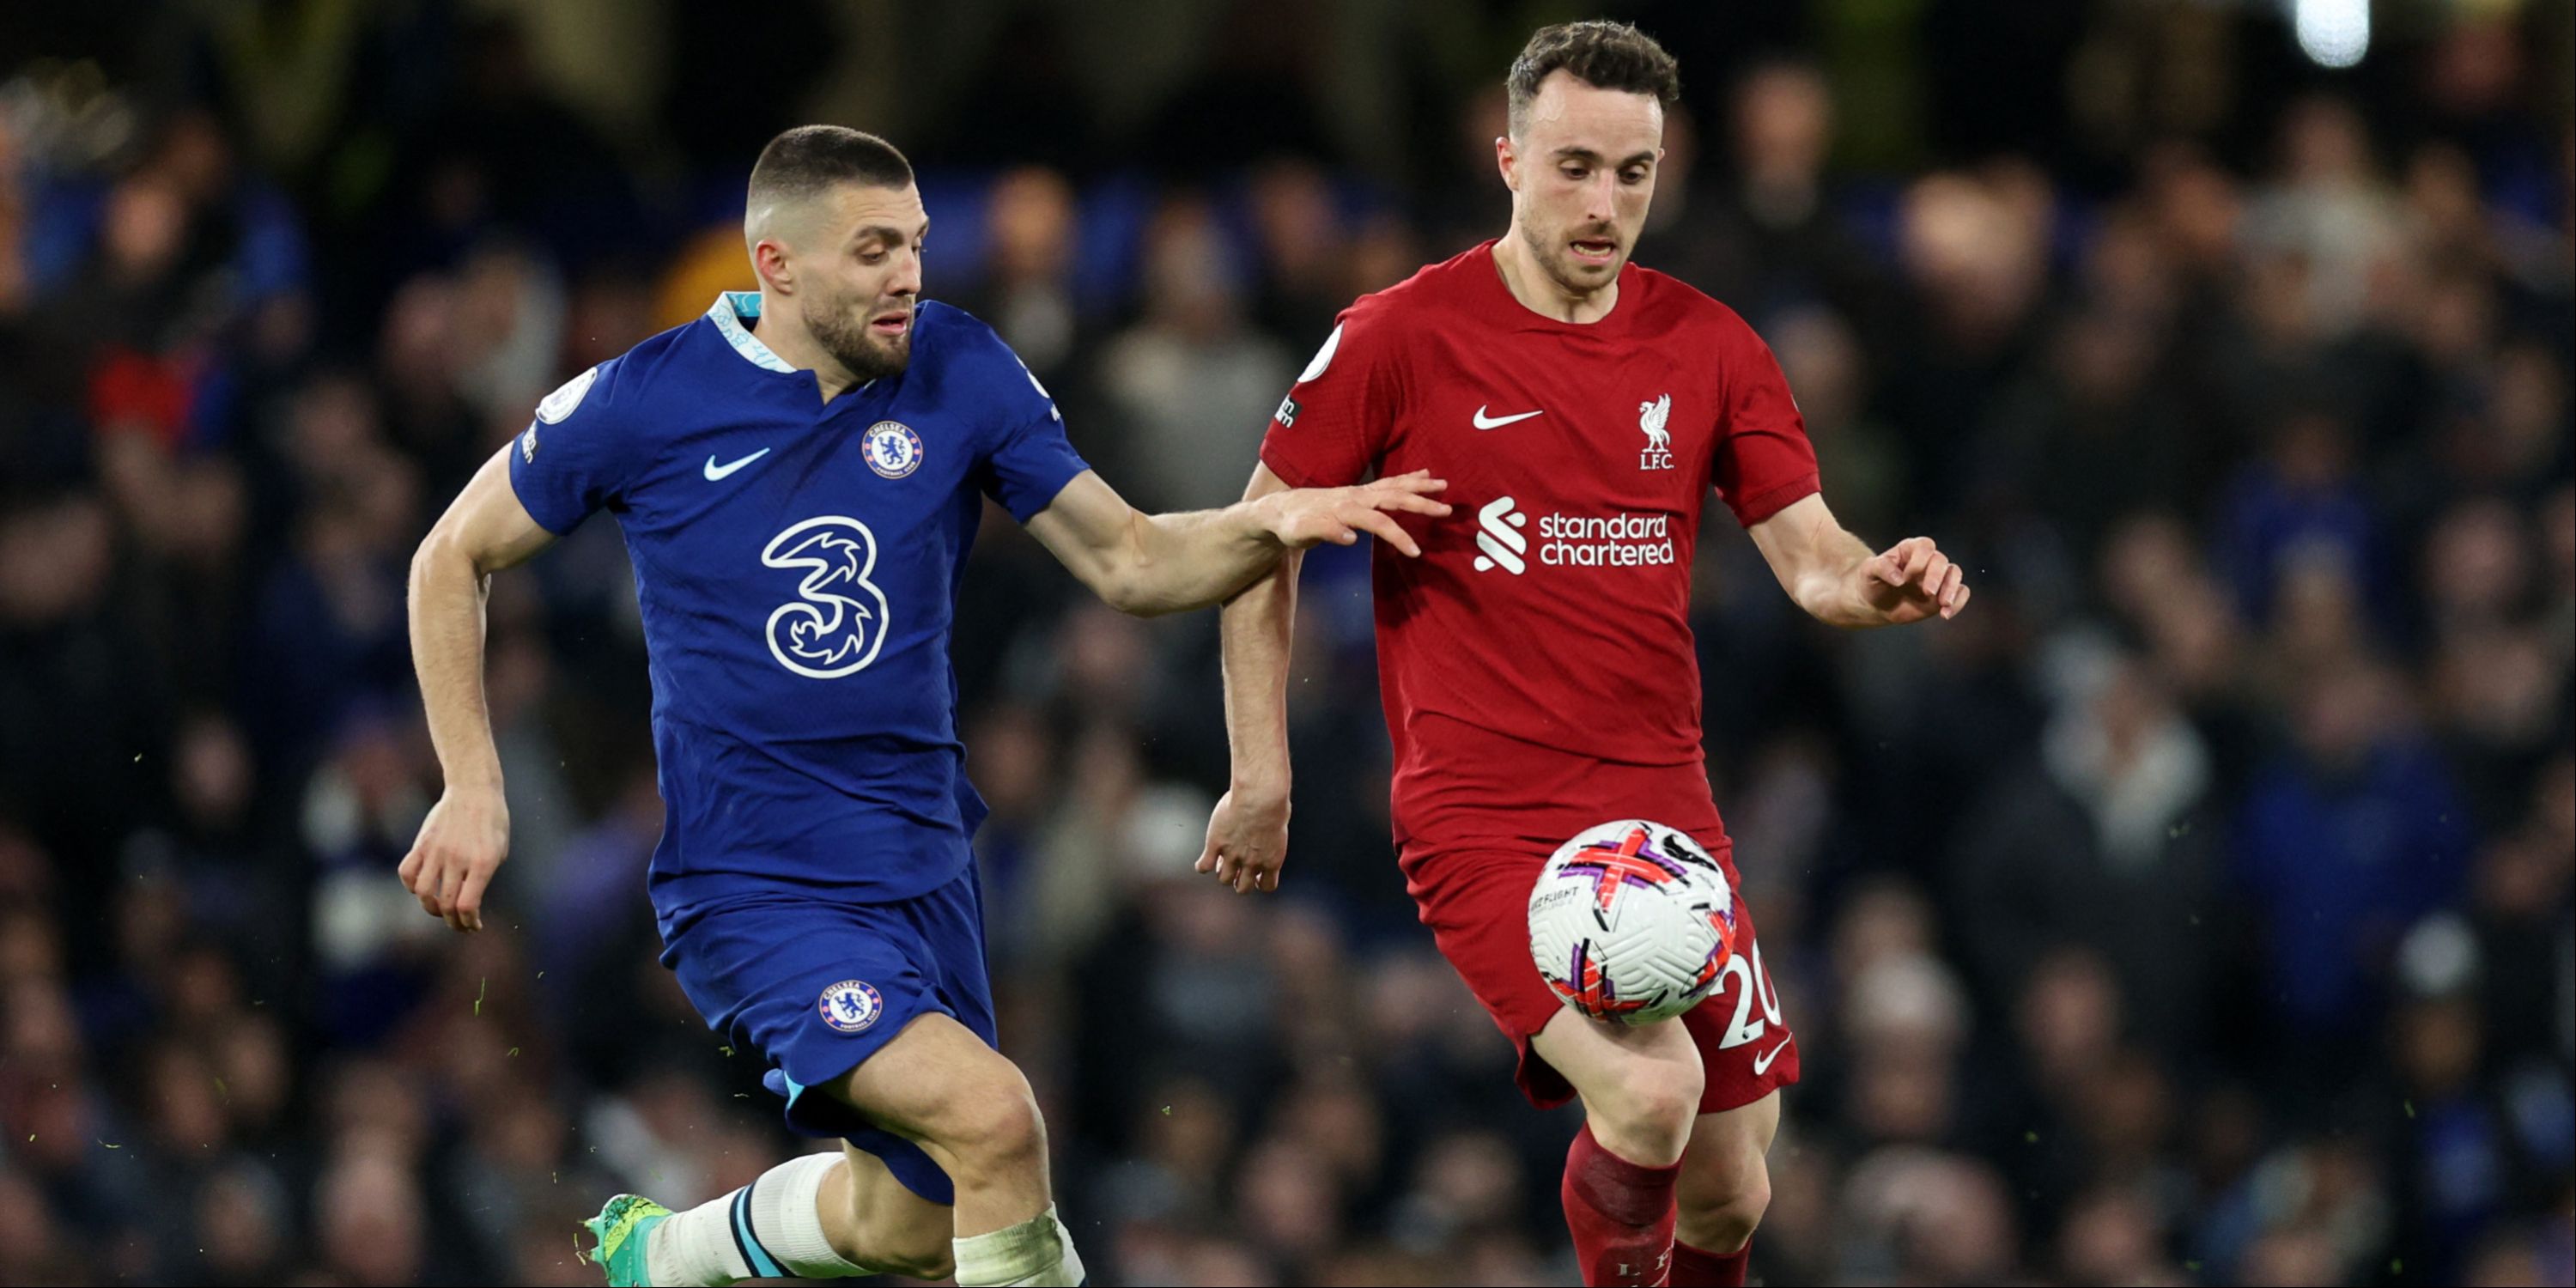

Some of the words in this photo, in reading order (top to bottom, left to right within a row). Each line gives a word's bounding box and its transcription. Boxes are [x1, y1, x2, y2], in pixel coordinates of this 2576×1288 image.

[869, 423, 906, 437] CHELSEA
[1539, 512, 1668, 539] standard
[1540, 538, 1674, 567] chartered
[761, 515, 890, 678] 3
[823, 982, 860, 999] CHELSEA
[1709, 938, 1782, 1049] 20
